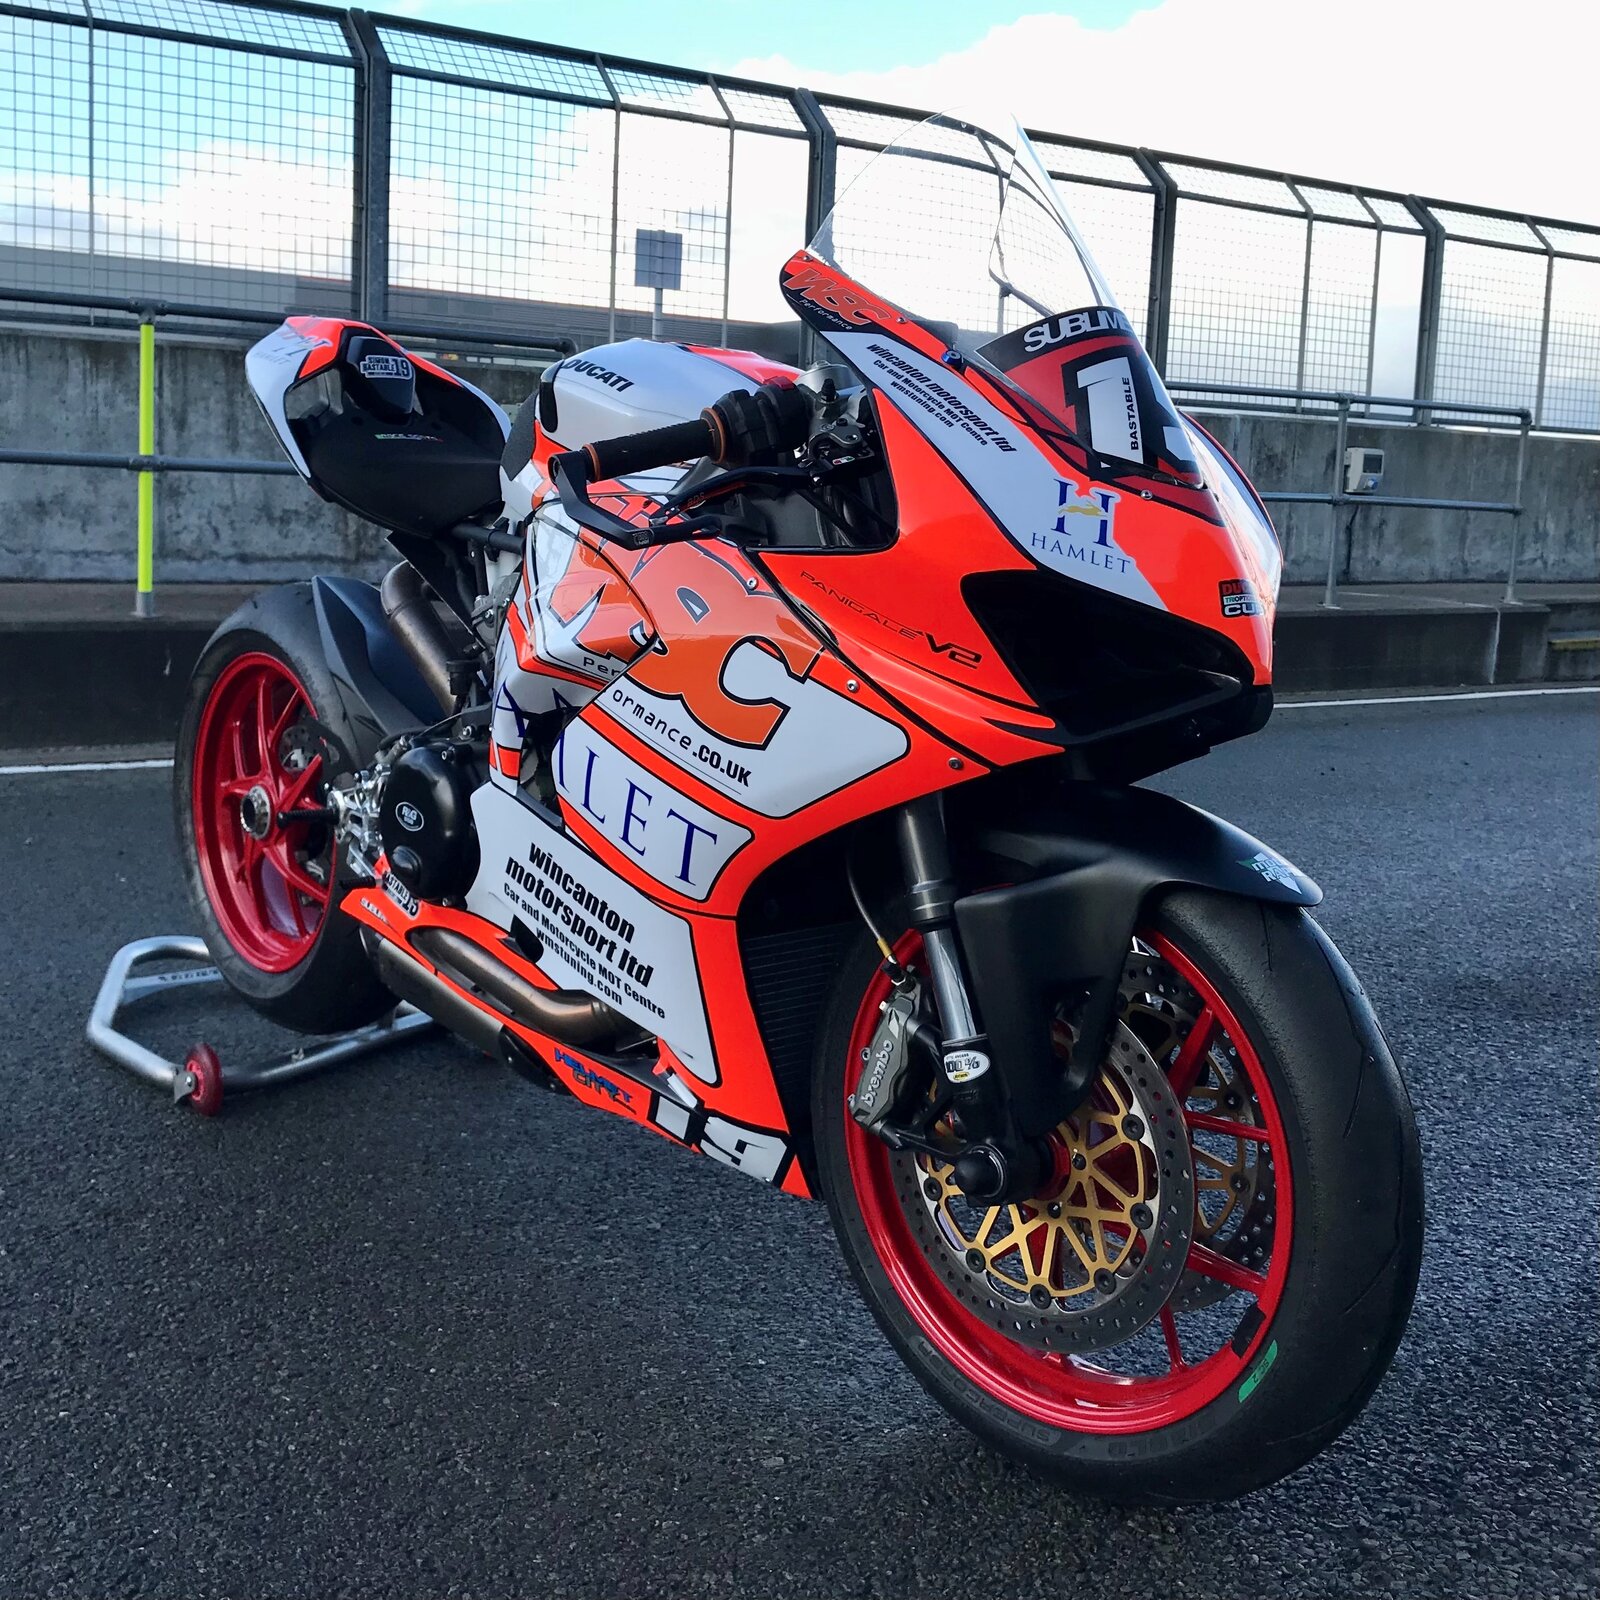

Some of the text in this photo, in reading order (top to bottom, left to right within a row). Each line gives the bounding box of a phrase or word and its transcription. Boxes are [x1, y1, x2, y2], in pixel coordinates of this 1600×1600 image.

[783, 267, 891, 326] WSC
[799, 299, 853, 331] Performance
[390, 357, 411, 377] 19
[560, 358, 635, 393] DUCATI
[866, 343, 1018, 453] wincanton motorsport ltd
[873, 359, 988, 447] Car and Motorcycle MOT Centre
[890, 381, 955, 429] wmstuning.com
[1121, 376, 1139, 451] BASTABLE
[1031, 532, 1132, 575] HAMLET
[923, 631, 983, 670] V2
[505, 856, 654, 988] motorsport ltd
[528, 842, 635, 944] wincanton
[503, 882, 666, 1019] Car and Motorcycle MOT Centre
[536, 927, 623, 1006] wmstuning.com
[554, 1047, 634, 1104] HELMET
[860, 1039, 894, 1108] brembo
